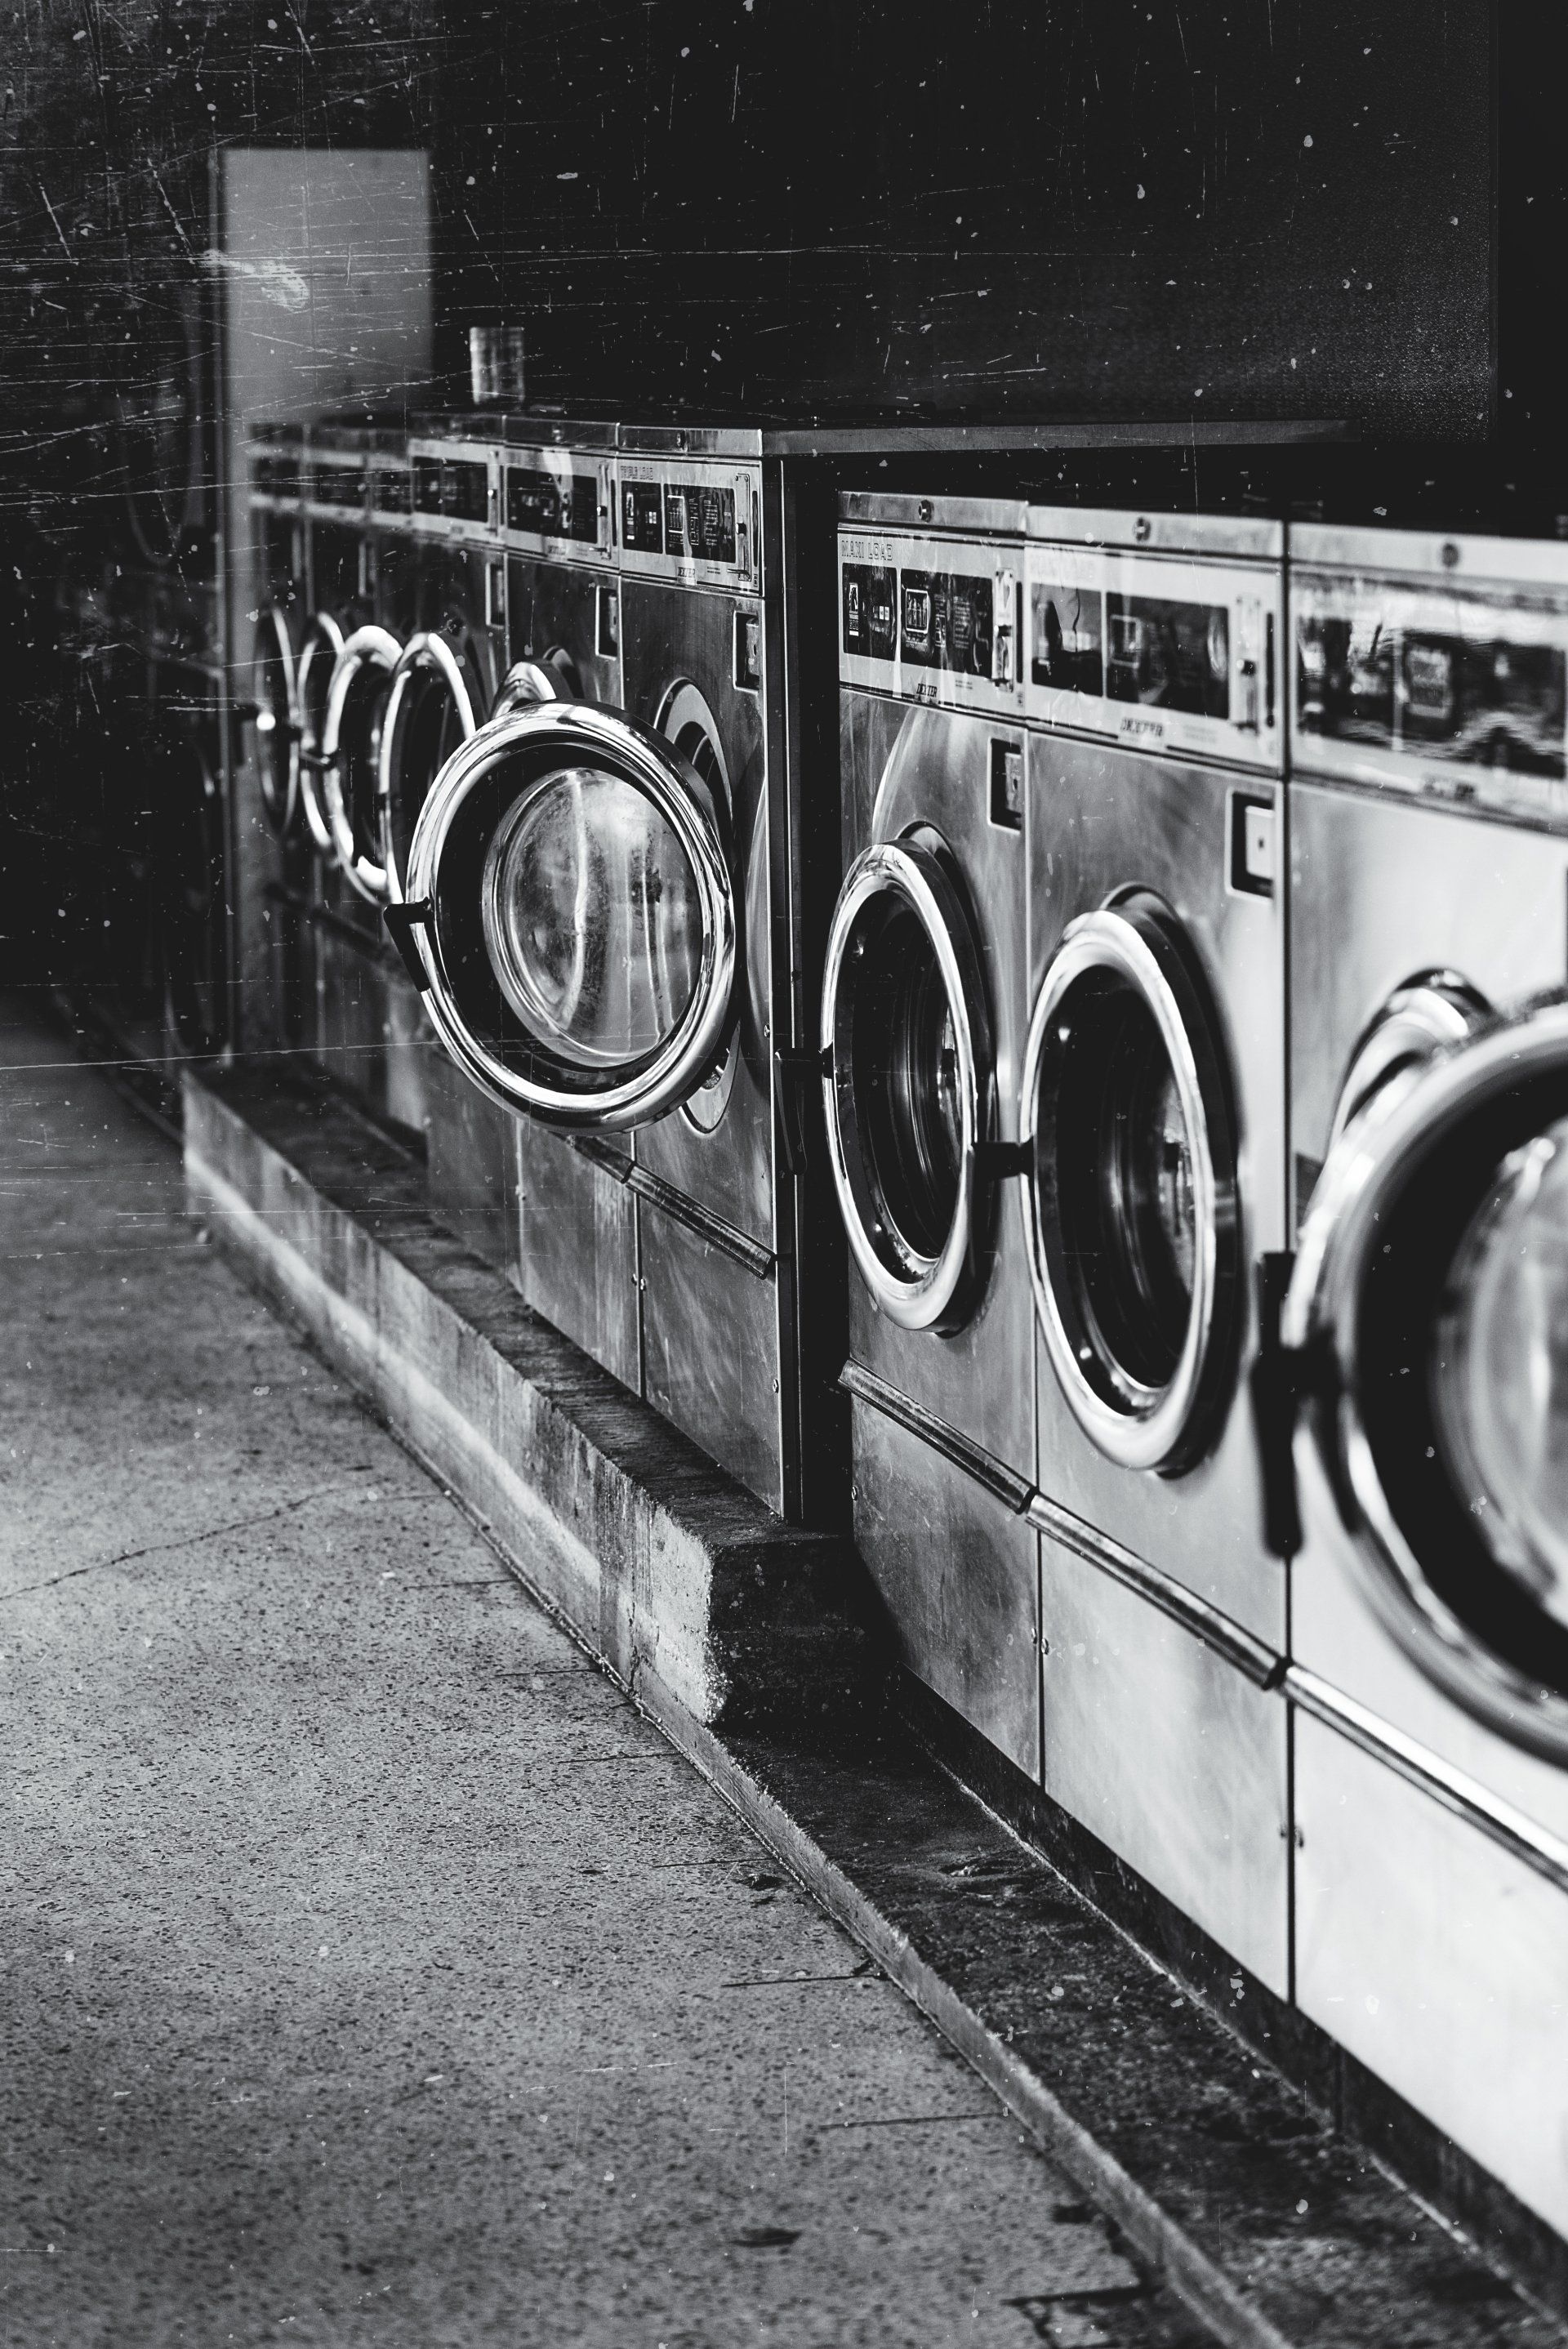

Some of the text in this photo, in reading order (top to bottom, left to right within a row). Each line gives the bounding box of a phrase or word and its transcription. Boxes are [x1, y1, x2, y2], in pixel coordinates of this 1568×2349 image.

[841, 540, 892, 561] MAXI LOAD
[916, 683, 938, 698] DEXTER
